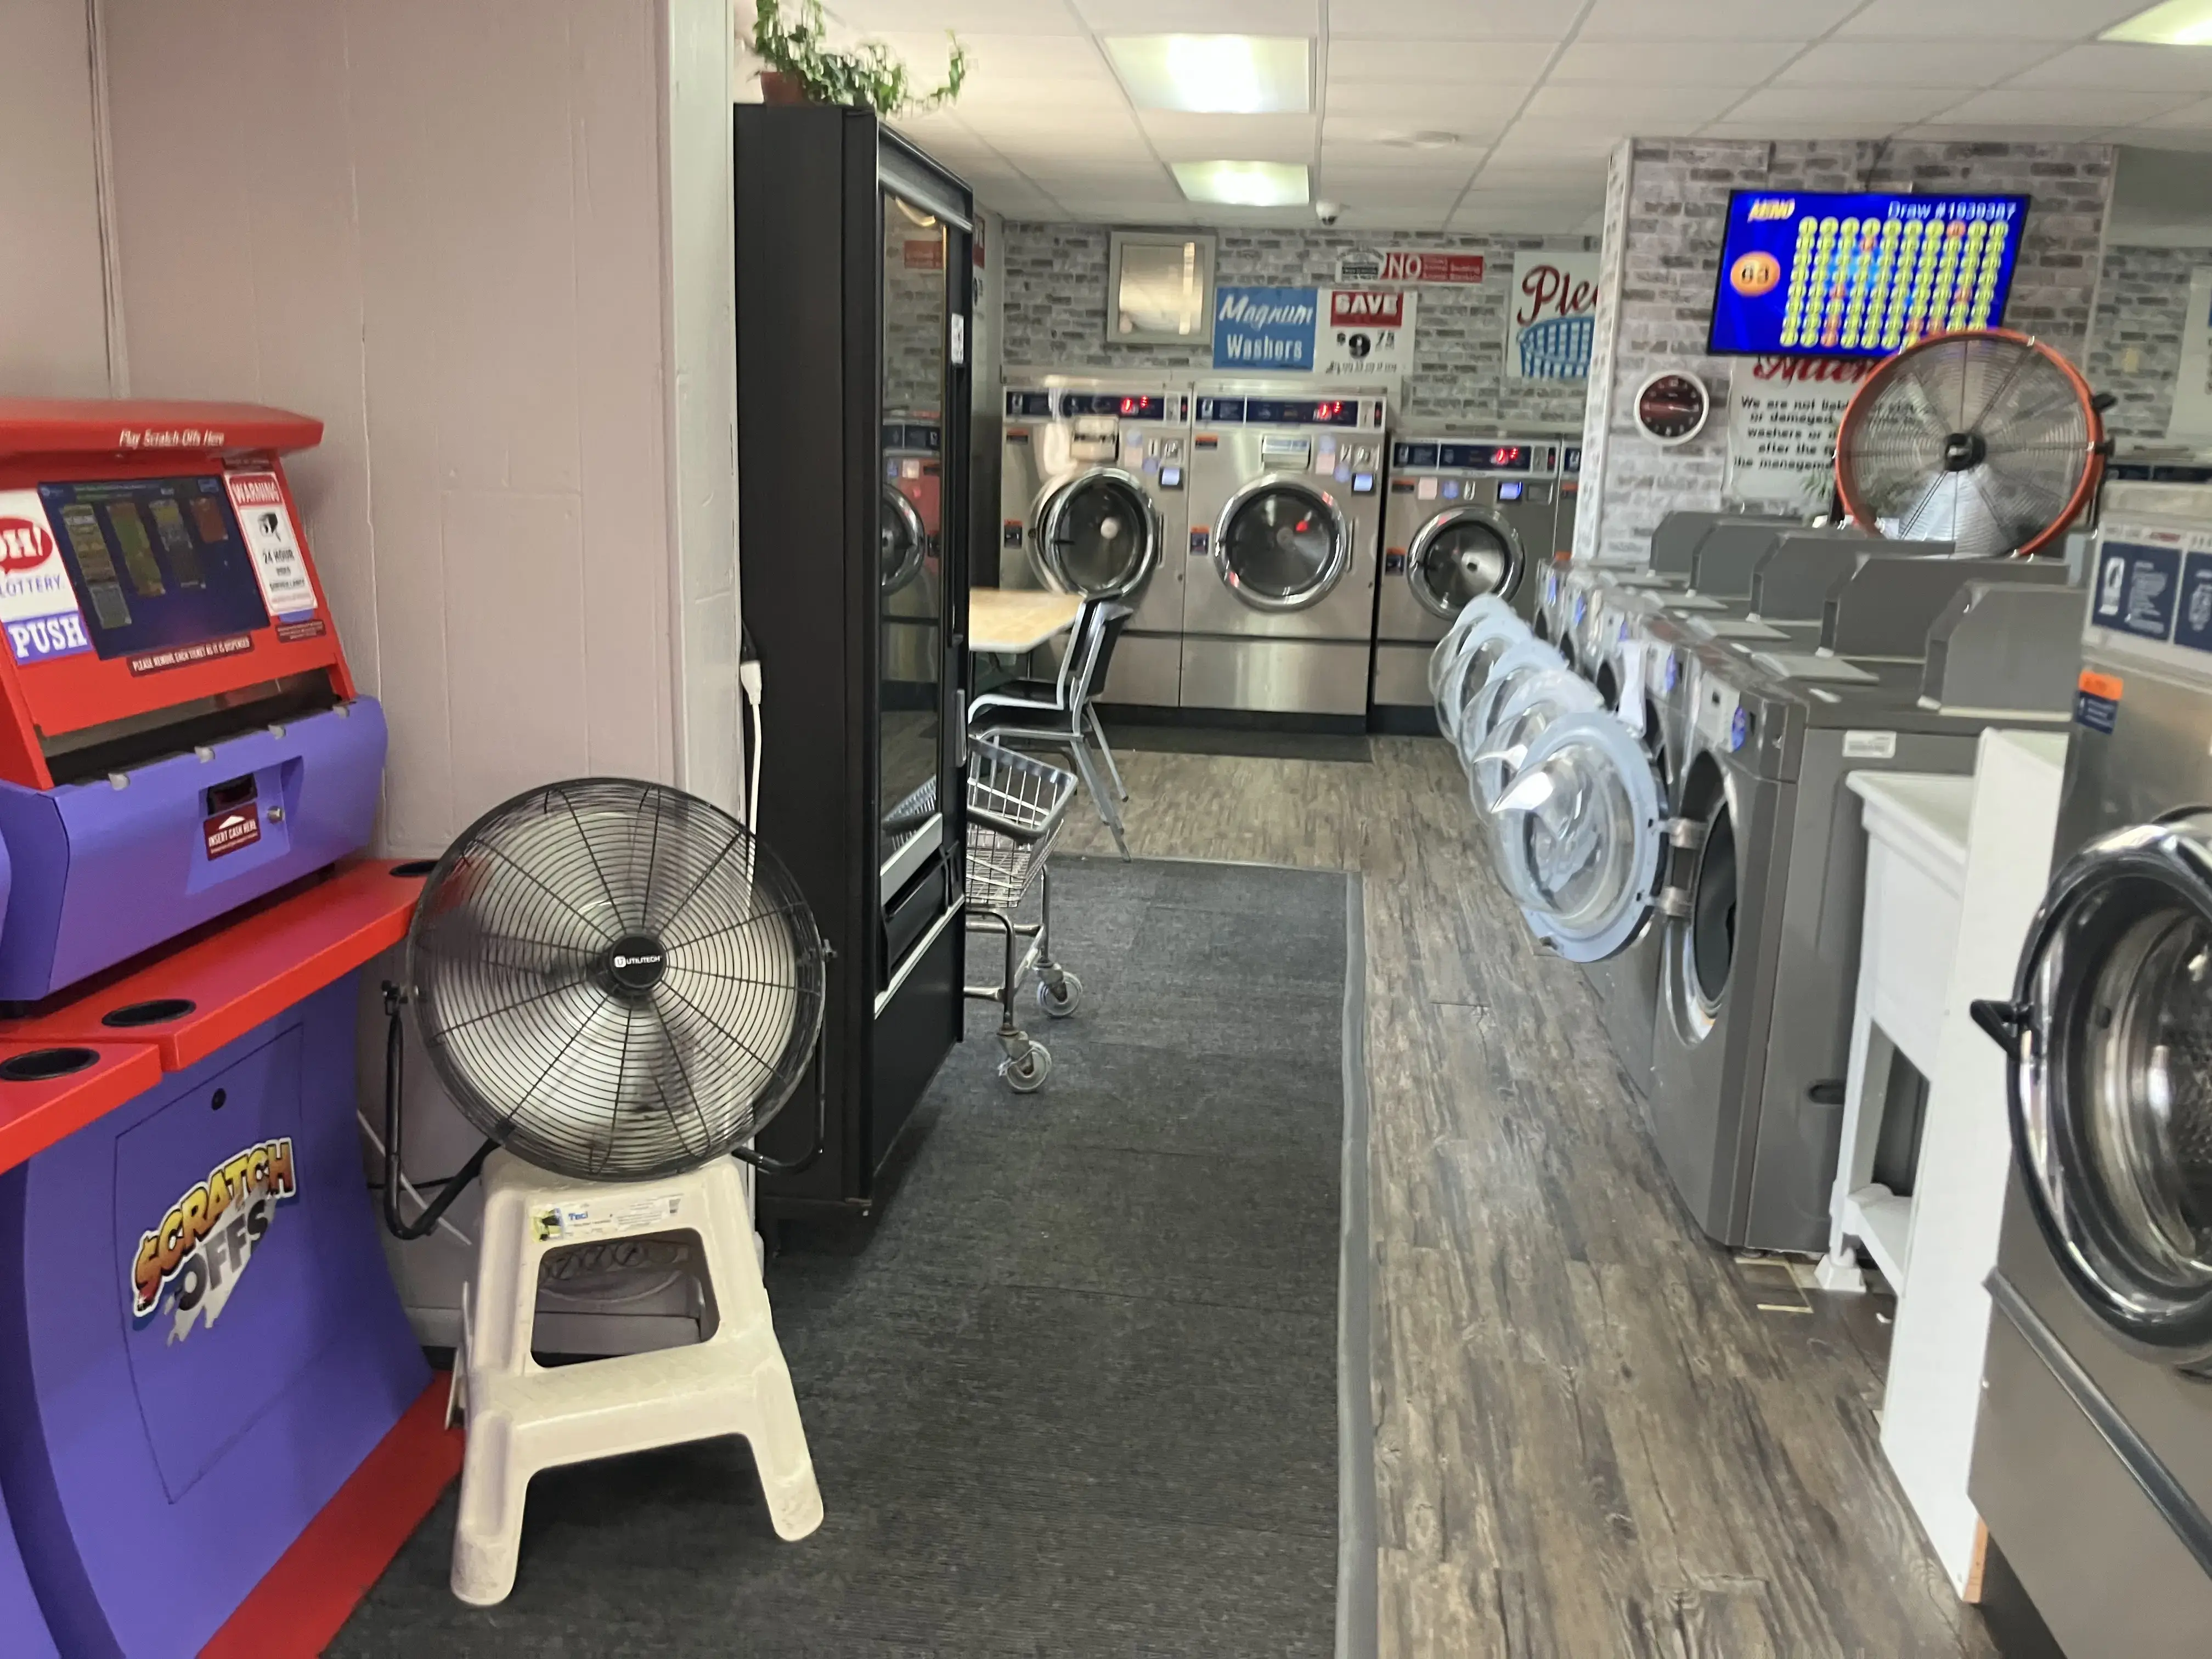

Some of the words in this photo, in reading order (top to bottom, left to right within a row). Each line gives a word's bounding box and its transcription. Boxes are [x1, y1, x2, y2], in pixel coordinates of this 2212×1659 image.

[1888, 201, 1931, 220] Draw
[1388, 253, 1422, 280] NO
[1218, 294, 1313, 331] Magnum
[1335, 294, 1398, 316] SAVE
[1227, 333, 1302, 362] Washers
[1741, 395, 1760, 409] We
[1767, 399, 1788, 409] are
[1794, 398, 1815, 410] not
[1750, 413, 1763, 424] or
[203, 428, 224, 447] Here
[1747, 427, 1802, 439] washers
[1808, 430, 1822, 439] or
[1758, 442, 1789, 454] after
[1796, 442, 1818, 454] the
[1734, 455, 1754, 467] the
[230, 482, 281, 503] WARNING
[274, 549, 295, 563] HOUR
[8, 614, 88, 658] PUSH
[132, 657, 154, 672] PLEASE
[208, 830, 228, 848] INSERT
[228, 824, 243, 840] CASH
[242, 819, 257, 834] HERE
[627, 955, 661, 965] UTILITECH
[136, 1139, 295, 1312] SCRATCH
[175, 1199, 269, 1312] OFFS
